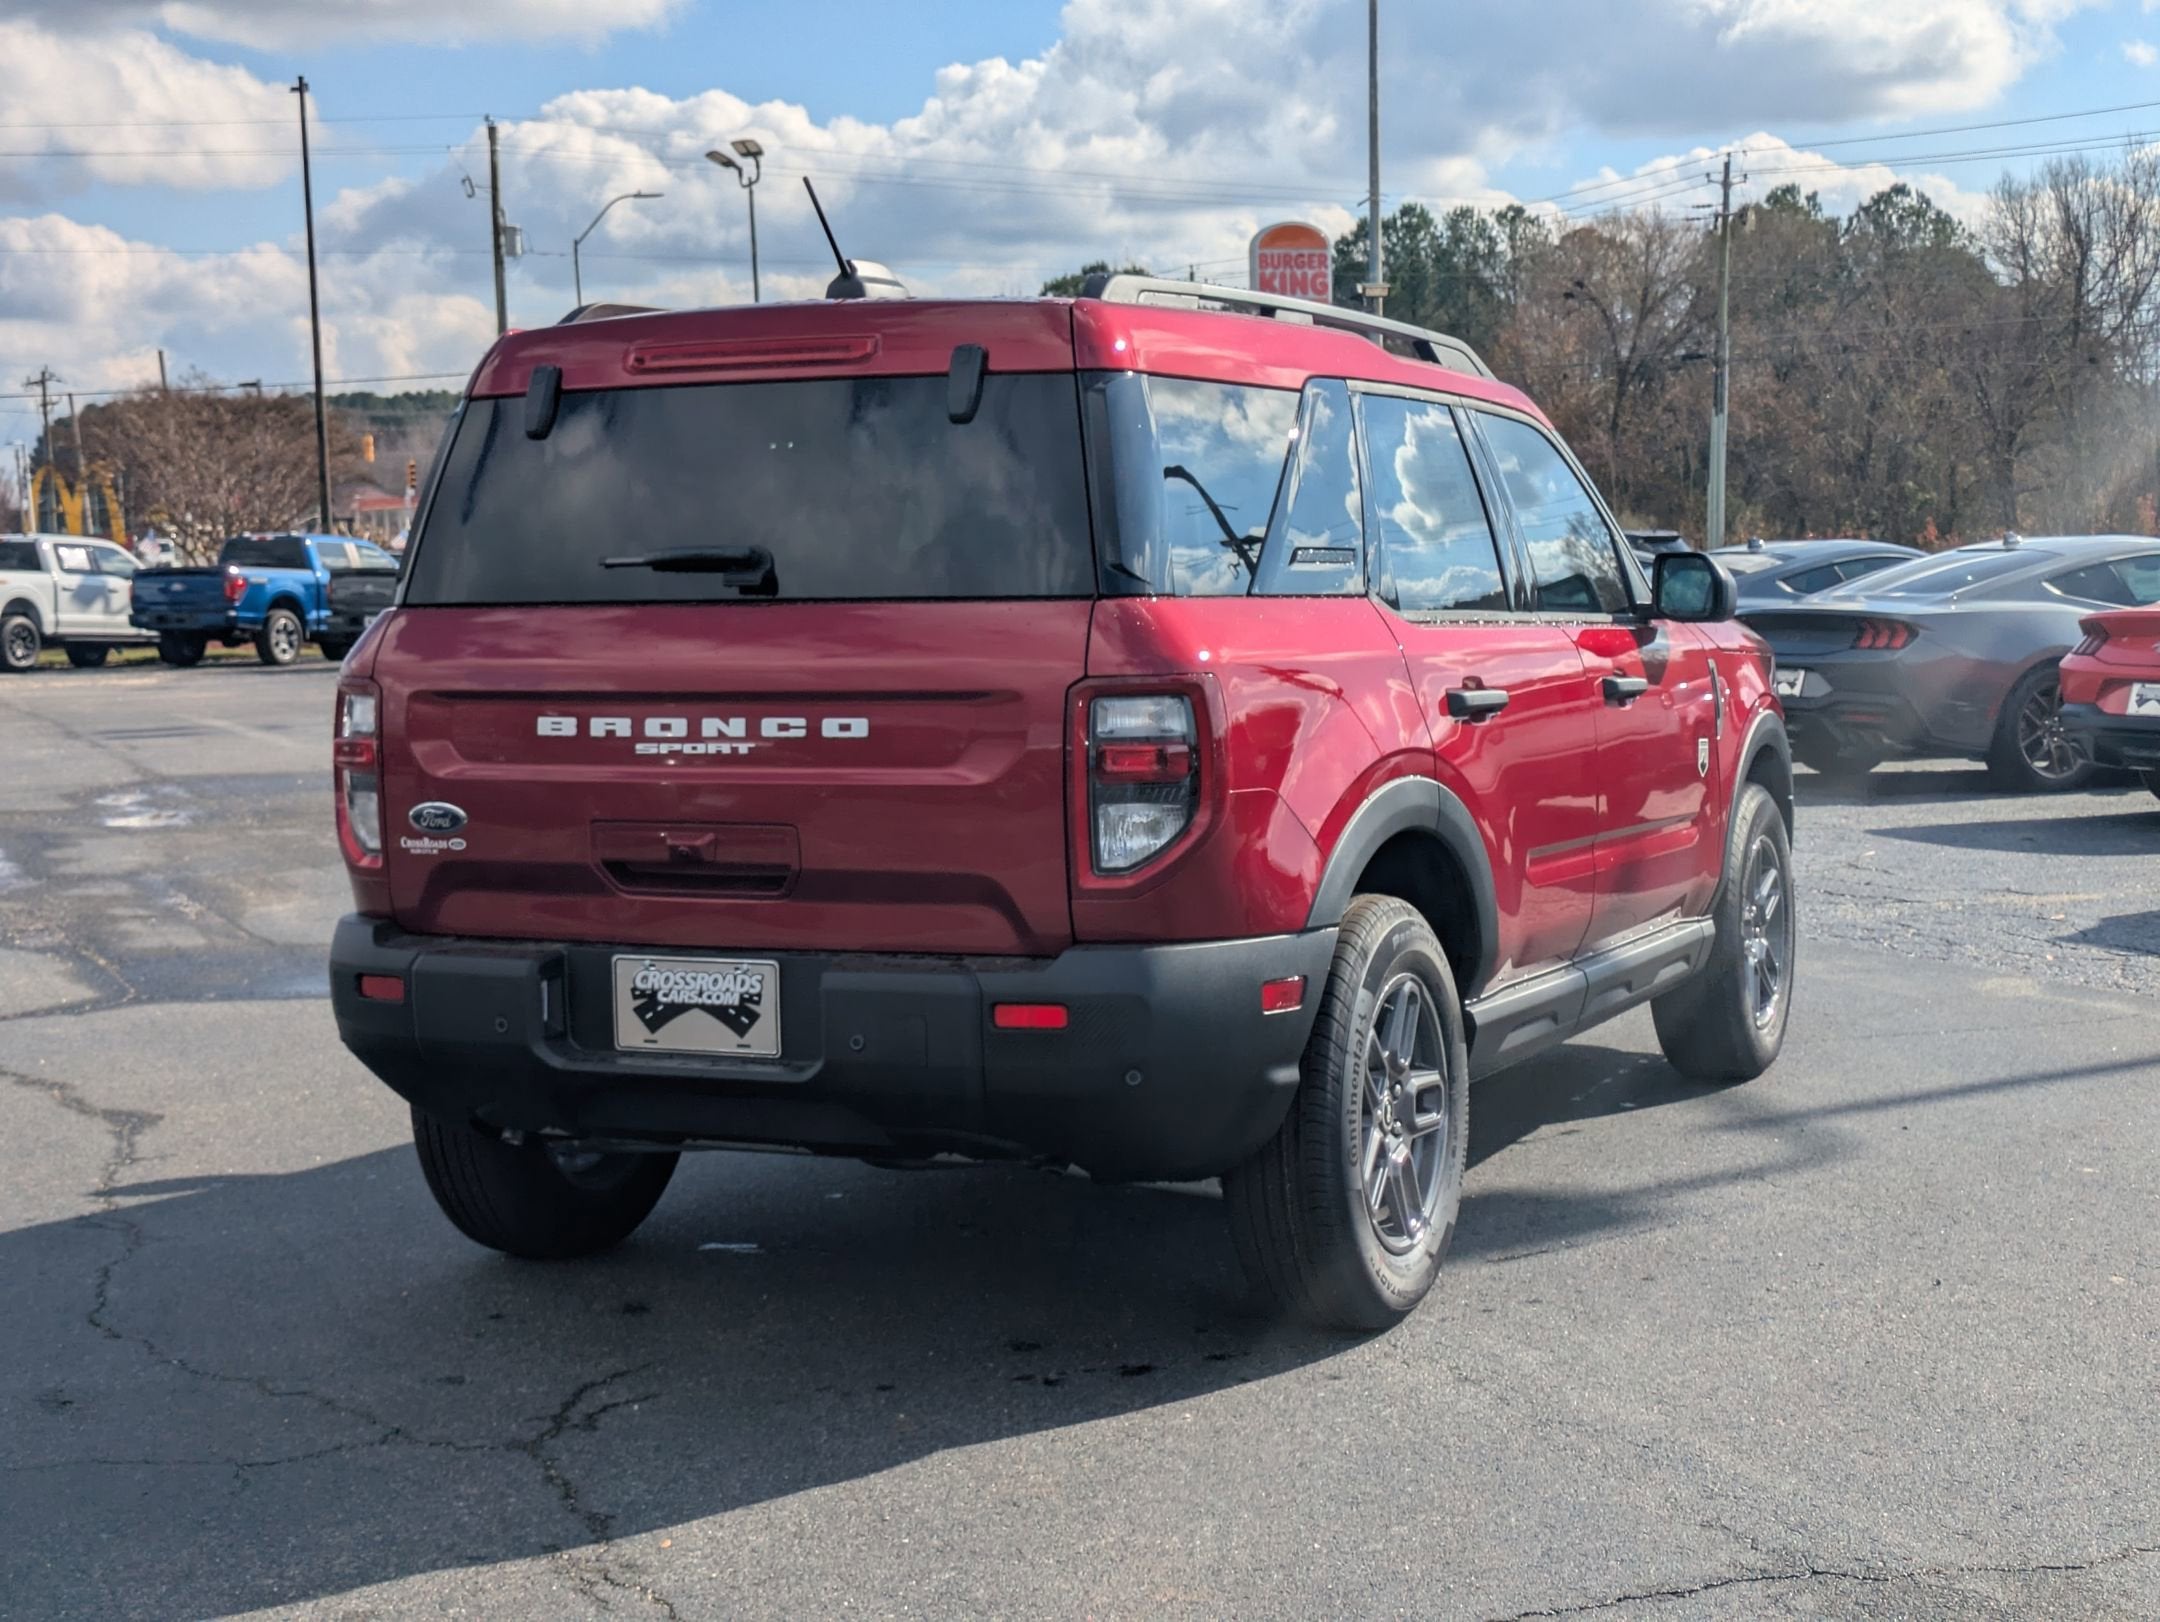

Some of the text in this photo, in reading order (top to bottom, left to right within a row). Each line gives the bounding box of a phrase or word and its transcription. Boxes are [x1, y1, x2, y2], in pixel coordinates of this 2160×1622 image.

[1258, 252, 1328, 271] BURGER
[1259, 271, 1329, 296] KING
[536, 716, 869, 739] BRONCO
[634, 743, 757, 755] SPORT
[420, 808, 453, 828] Ford
[634, 969, 764, 995] CROSSROADS
[656, 989, 741, 1006] CARS.COM
[1346, 1027, 1365, 1168] Continental
